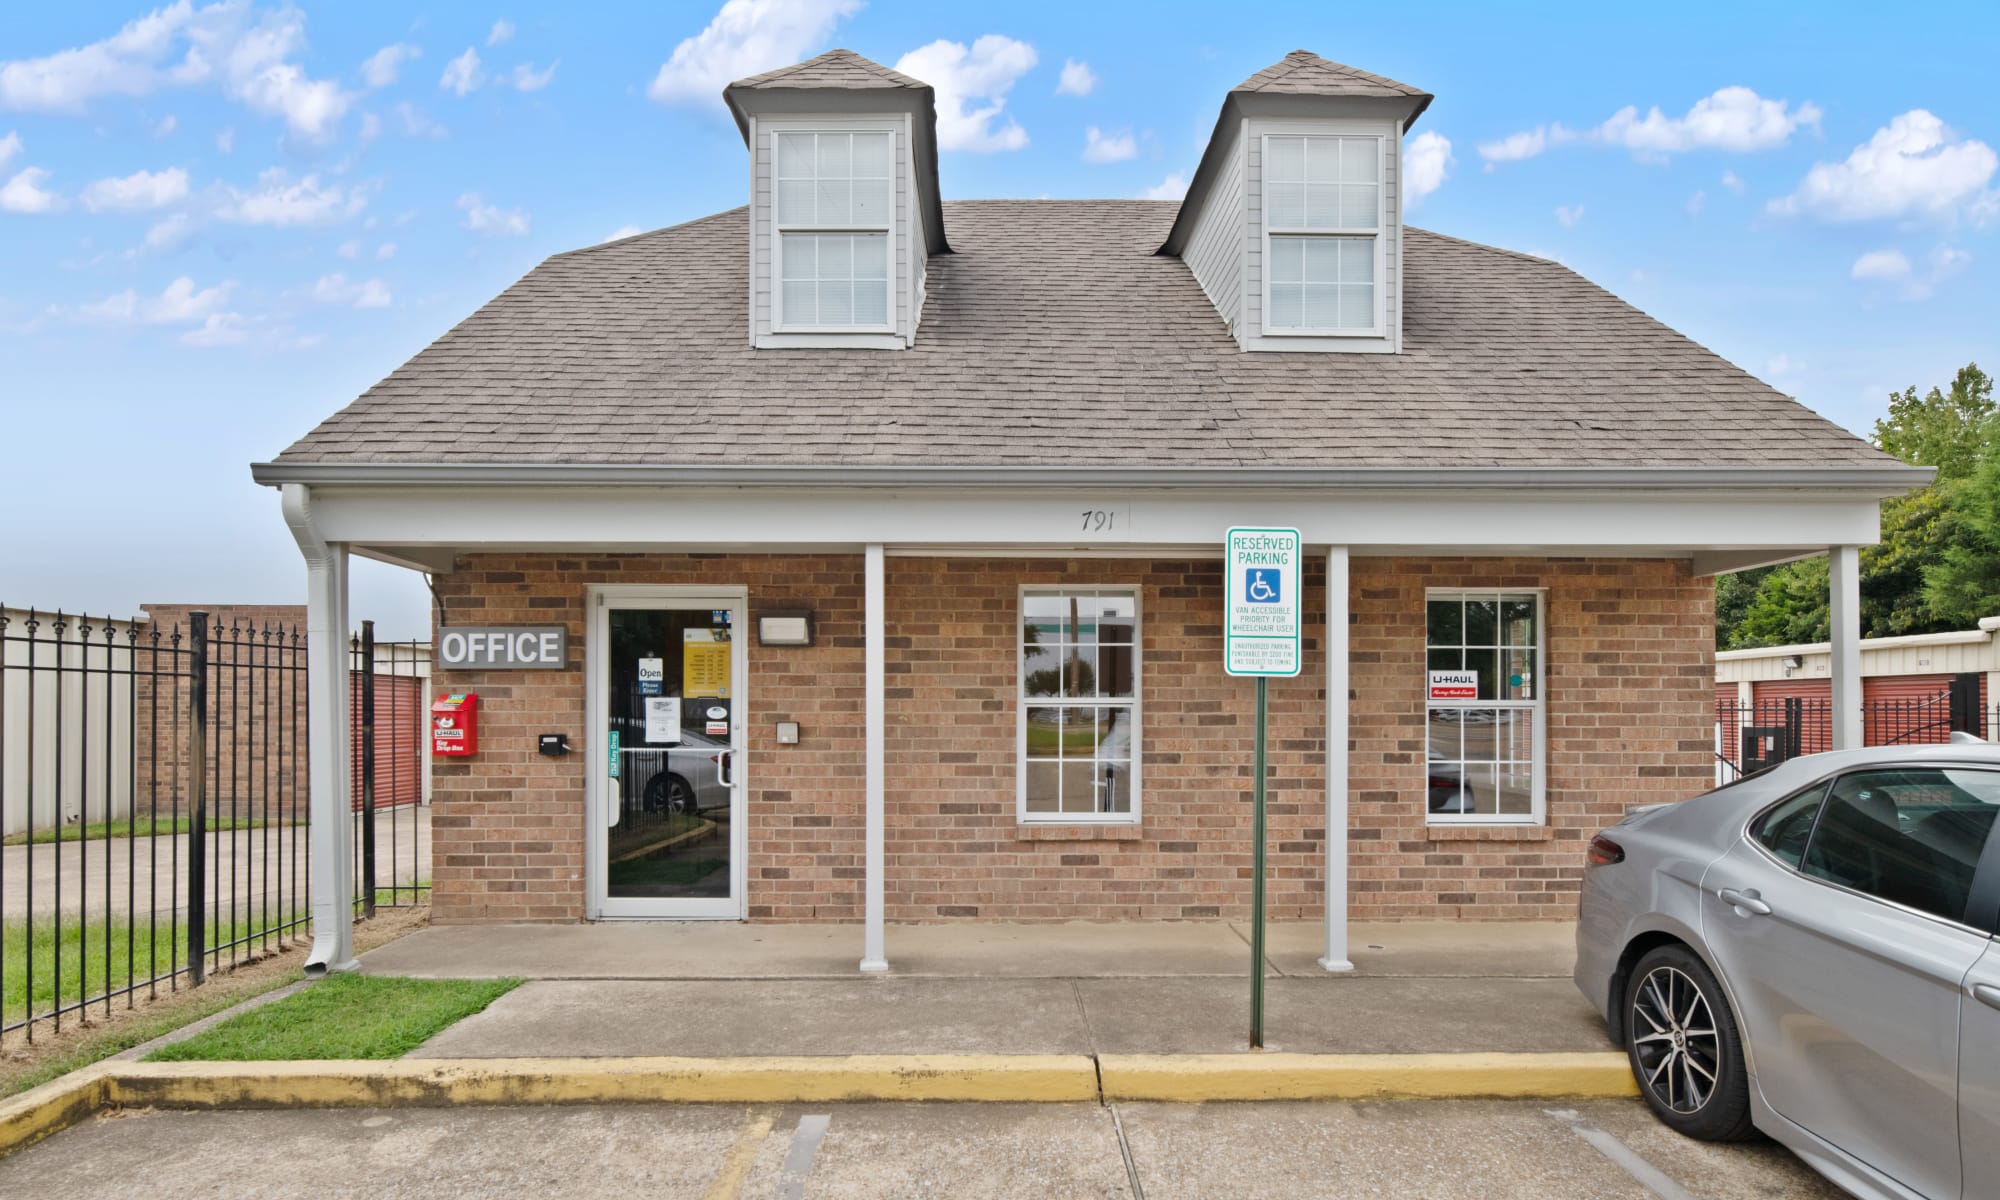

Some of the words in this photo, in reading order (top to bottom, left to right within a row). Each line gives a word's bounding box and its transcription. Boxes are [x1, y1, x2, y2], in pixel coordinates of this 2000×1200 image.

[1082, 510, 1114, 533] 791
[1233, 537, 1294, 550] RESERVED
[1238, 552, 1288, 565] PARKING
[1250, 607, 1292, 615] ACCESSIBLE
[1232, 624, 1274, 632] WHEELCHAIR
[442, 632, 560, 663] OFFICE
[640, 668, 662, 679] Open
[1433, 675, 1474, 683] U-HAUL
[1432, 689, 1449, 697] Moving
[610, 733, 618, 750] Drop
[610, 751, 618, 762] Key
